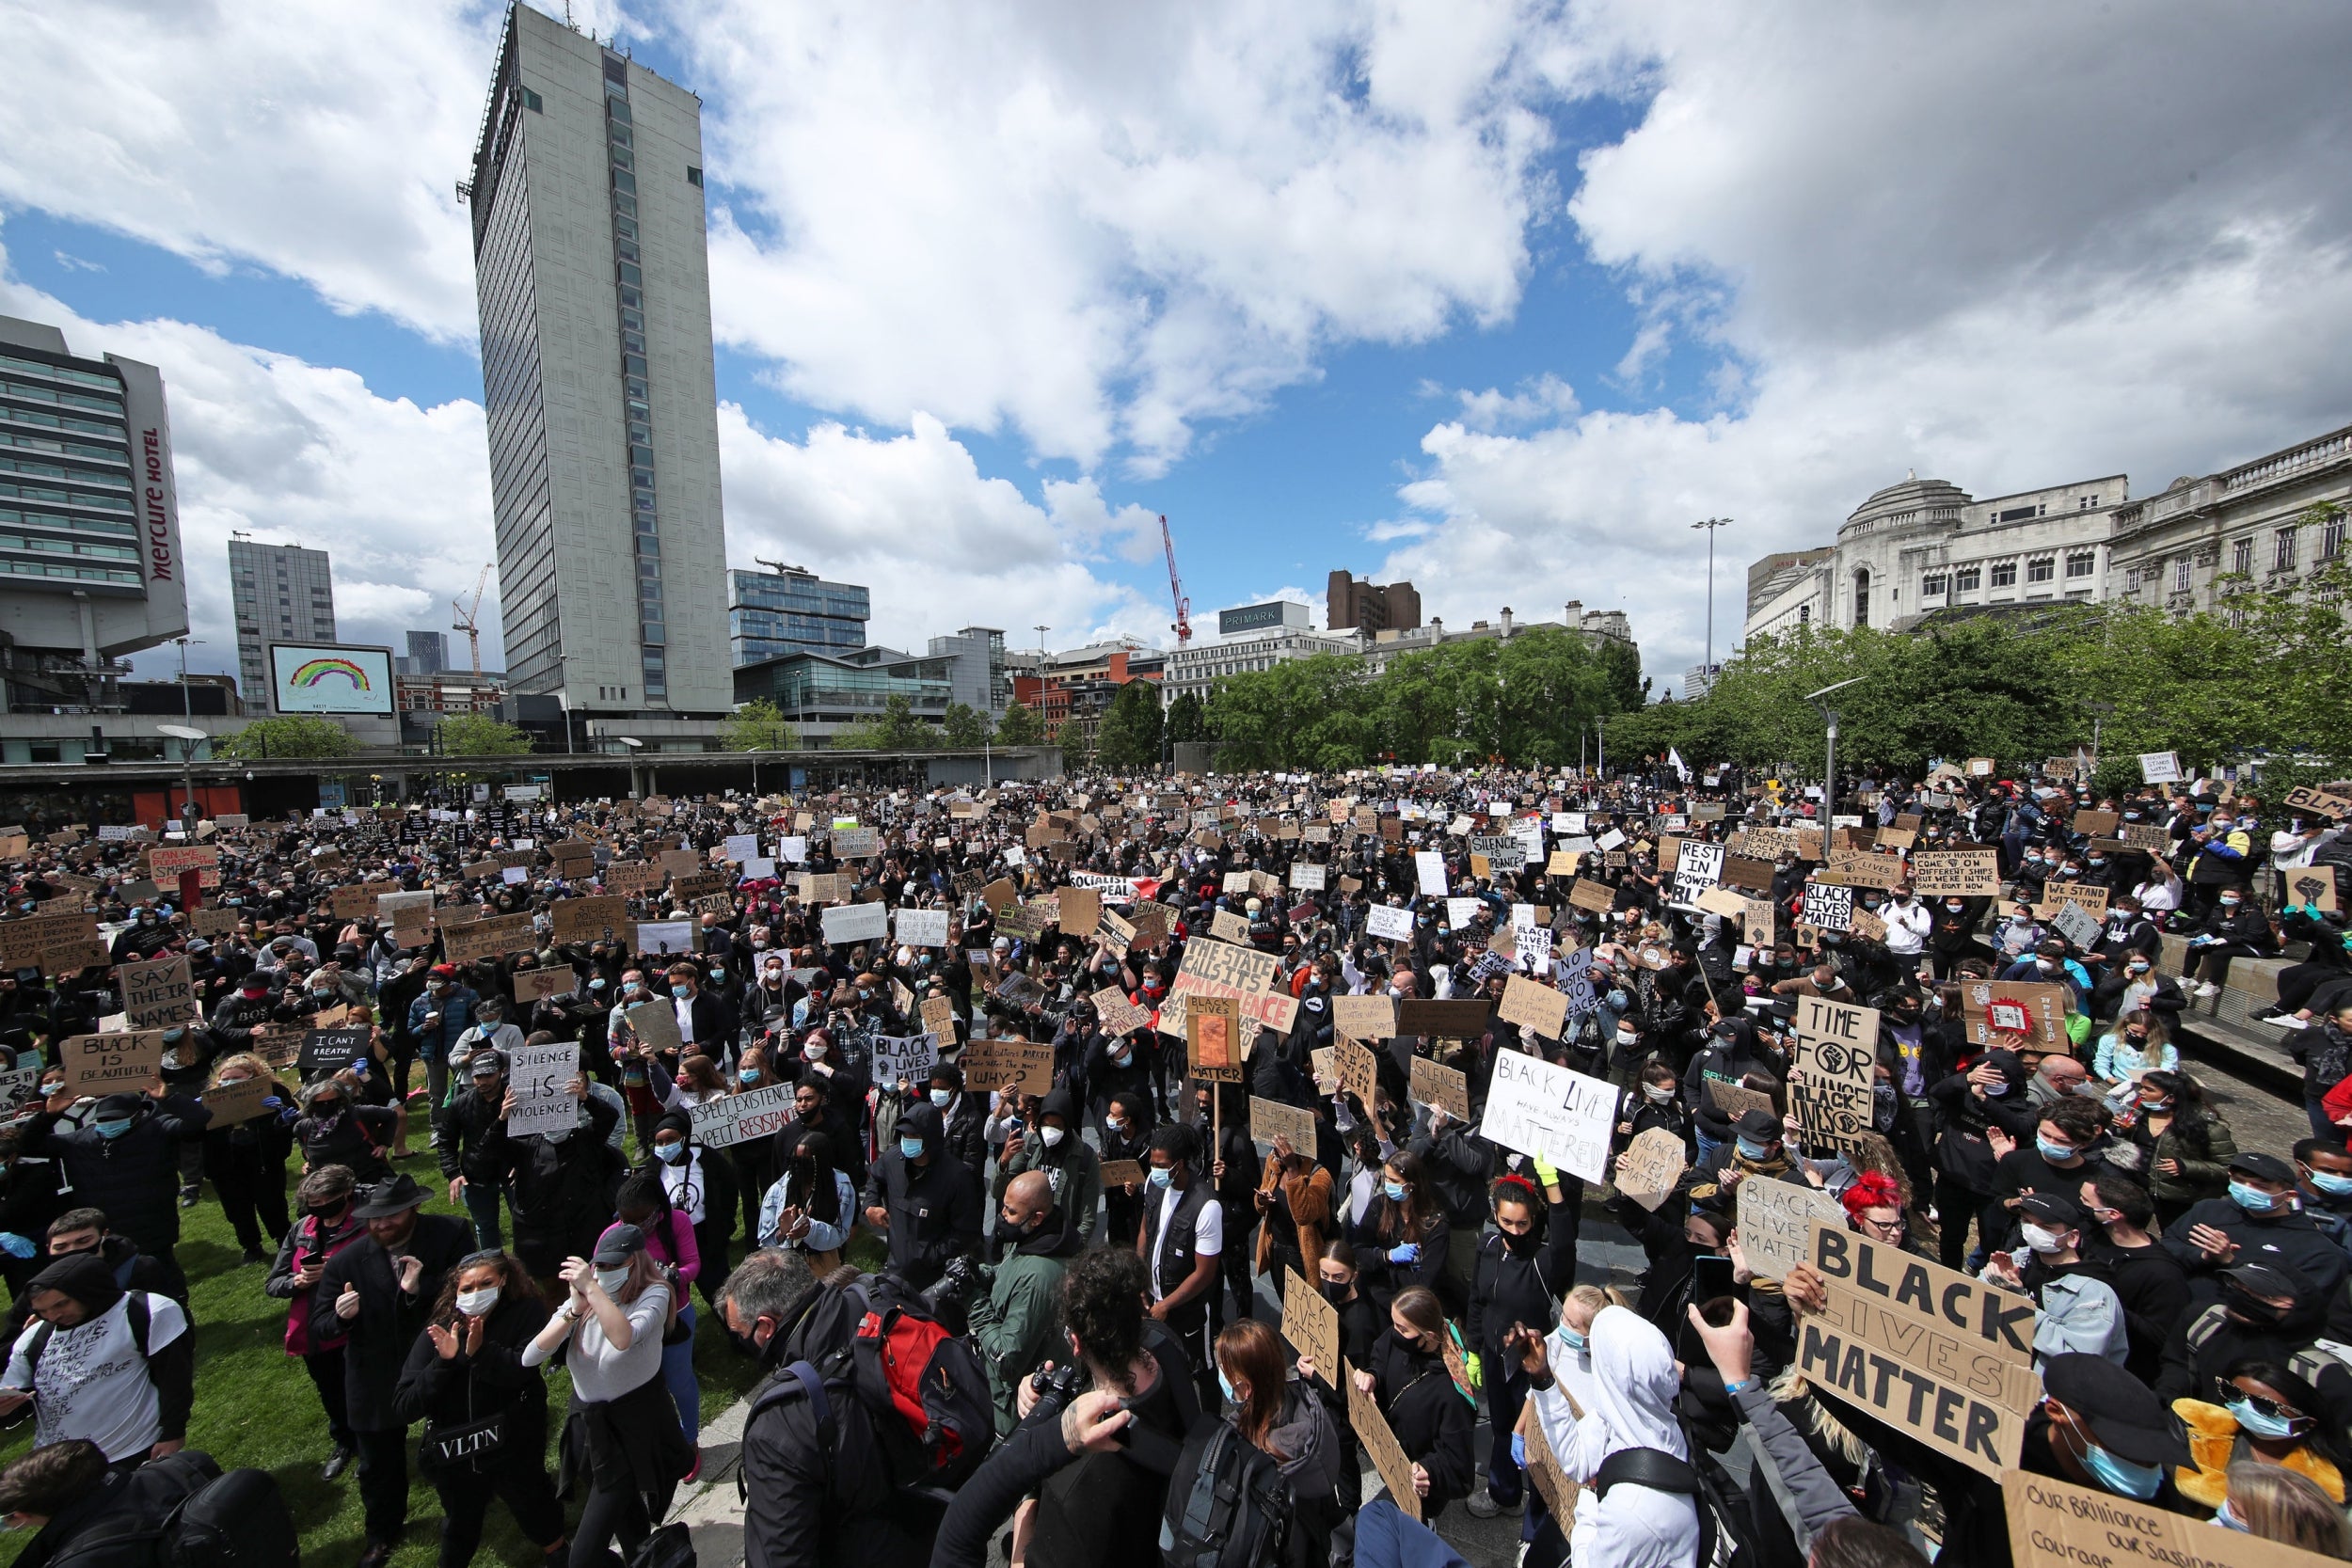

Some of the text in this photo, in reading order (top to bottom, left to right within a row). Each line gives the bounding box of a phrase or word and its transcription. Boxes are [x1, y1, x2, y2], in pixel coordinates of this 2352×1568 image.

[147, 427, 172, 581] mercure HOTEL
[1225, 610, 1276, 627] PRIMARK
[2289, 788, 2346, 813] BLM
[1747, 828, 1793, 842] BLACK IS
[2128, 833, 2165, 842] LIVES
[2129, 826, 2167, 835] BLACK
[1472, 837, 1517, 851] SILENCE
[1683, 843, 1723, 862] REST
[1742, 842, 1776, 852] BLACK
[2124, 840, 2167, 849] MATTER
[152, 850, 178, 859] CAN
[1829, 852, 1858, 863] BLACK
[608, 865, 655, 875] COUNTER
[1687, 859, 1710, 874] IN
[1862, 861, 1890, 874] LIVES
[608, 873, 648, 882] RACISM
[681, 875, 722, 886] SILENCE
[1677, 872, 1718, 888] POWER
[1806, 884, 1851, 903] BLACK
[2049, 884, 2105, 897] WE STAND
[575, 911, 612, 921] POLICE
[579, 904, 606, 912] STOP
[1748, 903, 1772, 911] BLACK
[1804, 901, 1850, 916] LIVES
[574, 918, 620, 927] BRUTALITY
[1803, 912, 1848, 929] MATTER
[559, 930, 595, 942] #BLM
[1518, 926, 1549, 939] BLACK
[2071, 921, 2085, 941] NEVER
[46, 941, 101, 958] SILENCE
[1516, 942, 1549, 956] MATTER
[1518, 935, 1549, 946] LIVES
[1189, 937, 1274, 975] THE STATE
[1481, 956, 1507, 974] RACE
[1488, 951, 1510, 967] ONE
[1561, 953, 1581, 973] NO
[131, 966, 176, 988] SAY
[1176, 972, 1204, 993] OWN
[1181, 956, 1261, 994] CALLS ITS
[1557, 964, 1591, 991] JUSTICE
[128, 983, 188, 1005] THEIR
[1565, 982, 1585, 1000] NO
[1191, 998, 1229, 1007] BLACK
[1196, 1005, 1230, 1015] LIVES
[131, 1003, 195, 1028] NAMES
[930, 1011, 941, 1020] IS
[1810, 1003, 1861, 1040] TIME
[928, 1018, 948, 1032] NOT
[84, 1035, 149, 1054] BLACK
[316, 1037, 326, 1046] I
[875, 1037, 930, 1055] BLACK
[102, 1053, 122, 1066] IS
[516, 1051, 572, 1067] SILENCE
[895, 1054, 930, 1070] LIVES
[1023, 1049, 1051, 1060] DARKER
[1796, 1035, 1872, 1084] FOR
[81, 1065, 152, 1081] BEAUTIFUL
[1190, 1067, 1242, 1081] MATTER
[1414, 1059, 1465, 1092] SILENCE
[532, 1074, 555, 1099] IS
[1430, 1081, 1440, 1095] IS
[1499, 1056, 1613, 1122] BLACK LIVES
[1713, 1081, 1763, 1106] BLACK
[734, 1084, 794, 1113] EXISTENCE
[1793, 1085, 1857, 1112] BLACK
[510, 1101, 571, 1118] VIOLENCE
[727, 1114, 739, 1122] OR
[1253, 1101, 1294, 1124] BLACK
[1517, 1099, 1580, 1127] HAVE ALWAYS
[1792, 1099, 1836, 1134] LIVES
[1486, 1103, 1603, 1172] MATTERED
[1799, 1129, 1866, 1156] MATTER
[1639, 1132, 1677, 1163] BLACK
[1630, 1150, 1664, 1179] LIVES
[1624, 1166, 1664, 1196] MATTER
[1746, 1181, 1817, 1217] BLACK
[1285, 1268, 1329, 1327] BLACK
[1817, 1227, 2035, 1355] BLACK
[1285, 1298, 1327, 1354] LIVES
[1282, 1307, 1335, 1383] MATTER
[1818, 1286, 2003, 1398] LIVES
[1801, 1323, 2003, 1467] MATTER
[438, 1425, 501, 1460] VLTN
[2026, 1484, 2070, 1514] OUR
[2106, 1530, 2145, 1554] OUR
